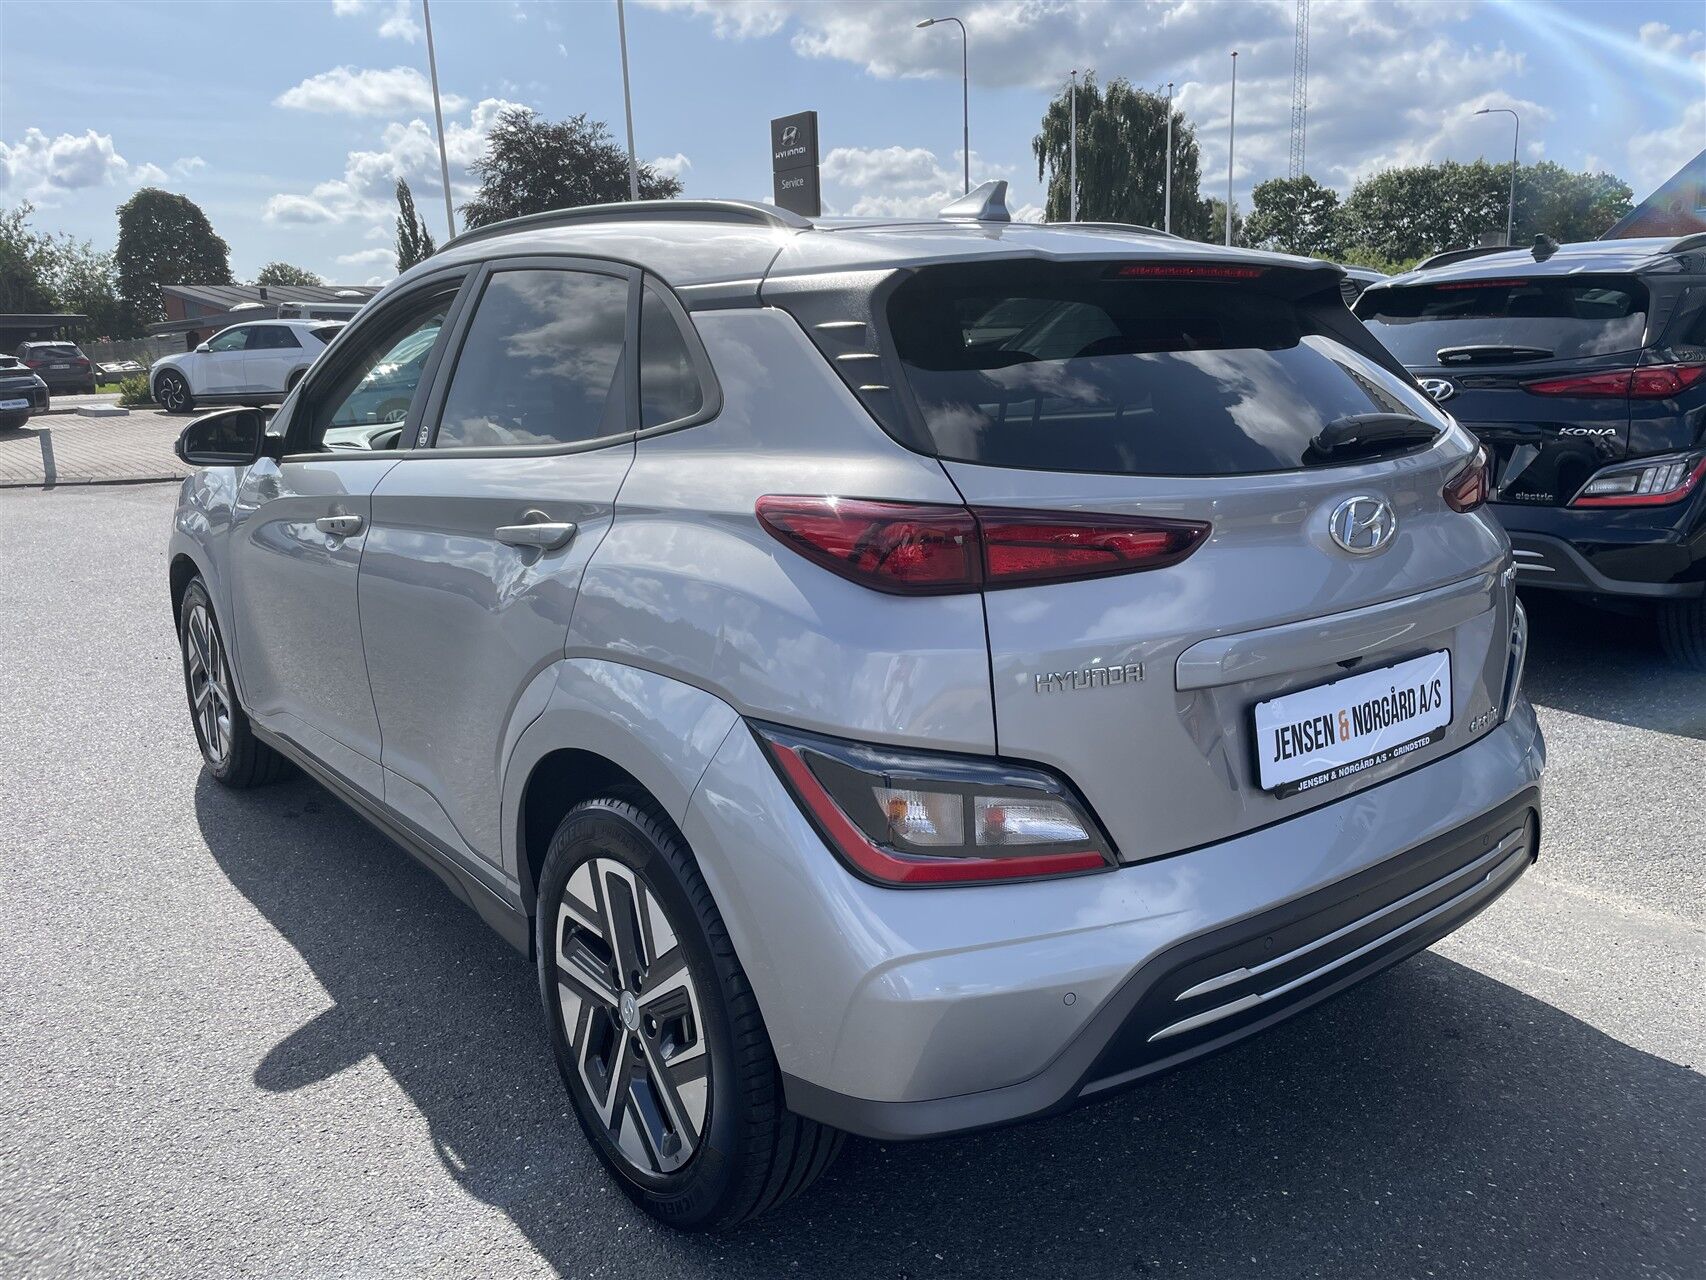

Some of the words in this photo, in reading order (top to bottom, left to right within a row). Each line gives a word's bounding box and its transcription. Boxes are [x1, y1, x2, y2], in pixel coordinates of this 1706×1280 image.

[775, 146, 806, 159] HYUNDAI
[781, 177, 804, 190] Service
[1558, 427, 1617, 436] KONA
[1515, 491, 1554, 501] electric
[1035, 662, 1146, 693] HYUNDAI
[1274, 713, 1335, 763] JENSEN
[1338, 709, 1350, 742] &
[1351, 686, 1416, 738] NØRGÅRD
[1419, 678, 1442, 715] A/S
[1297, 772, 1330, 791] JENSEN
[1330, 771, 1337, 780] &
[1338, 758, 1374, 777] NØRGÅRD
[1375, 752, 1387, 765] A/S
[1393, 736, 1430, 757] GRINDSTED
